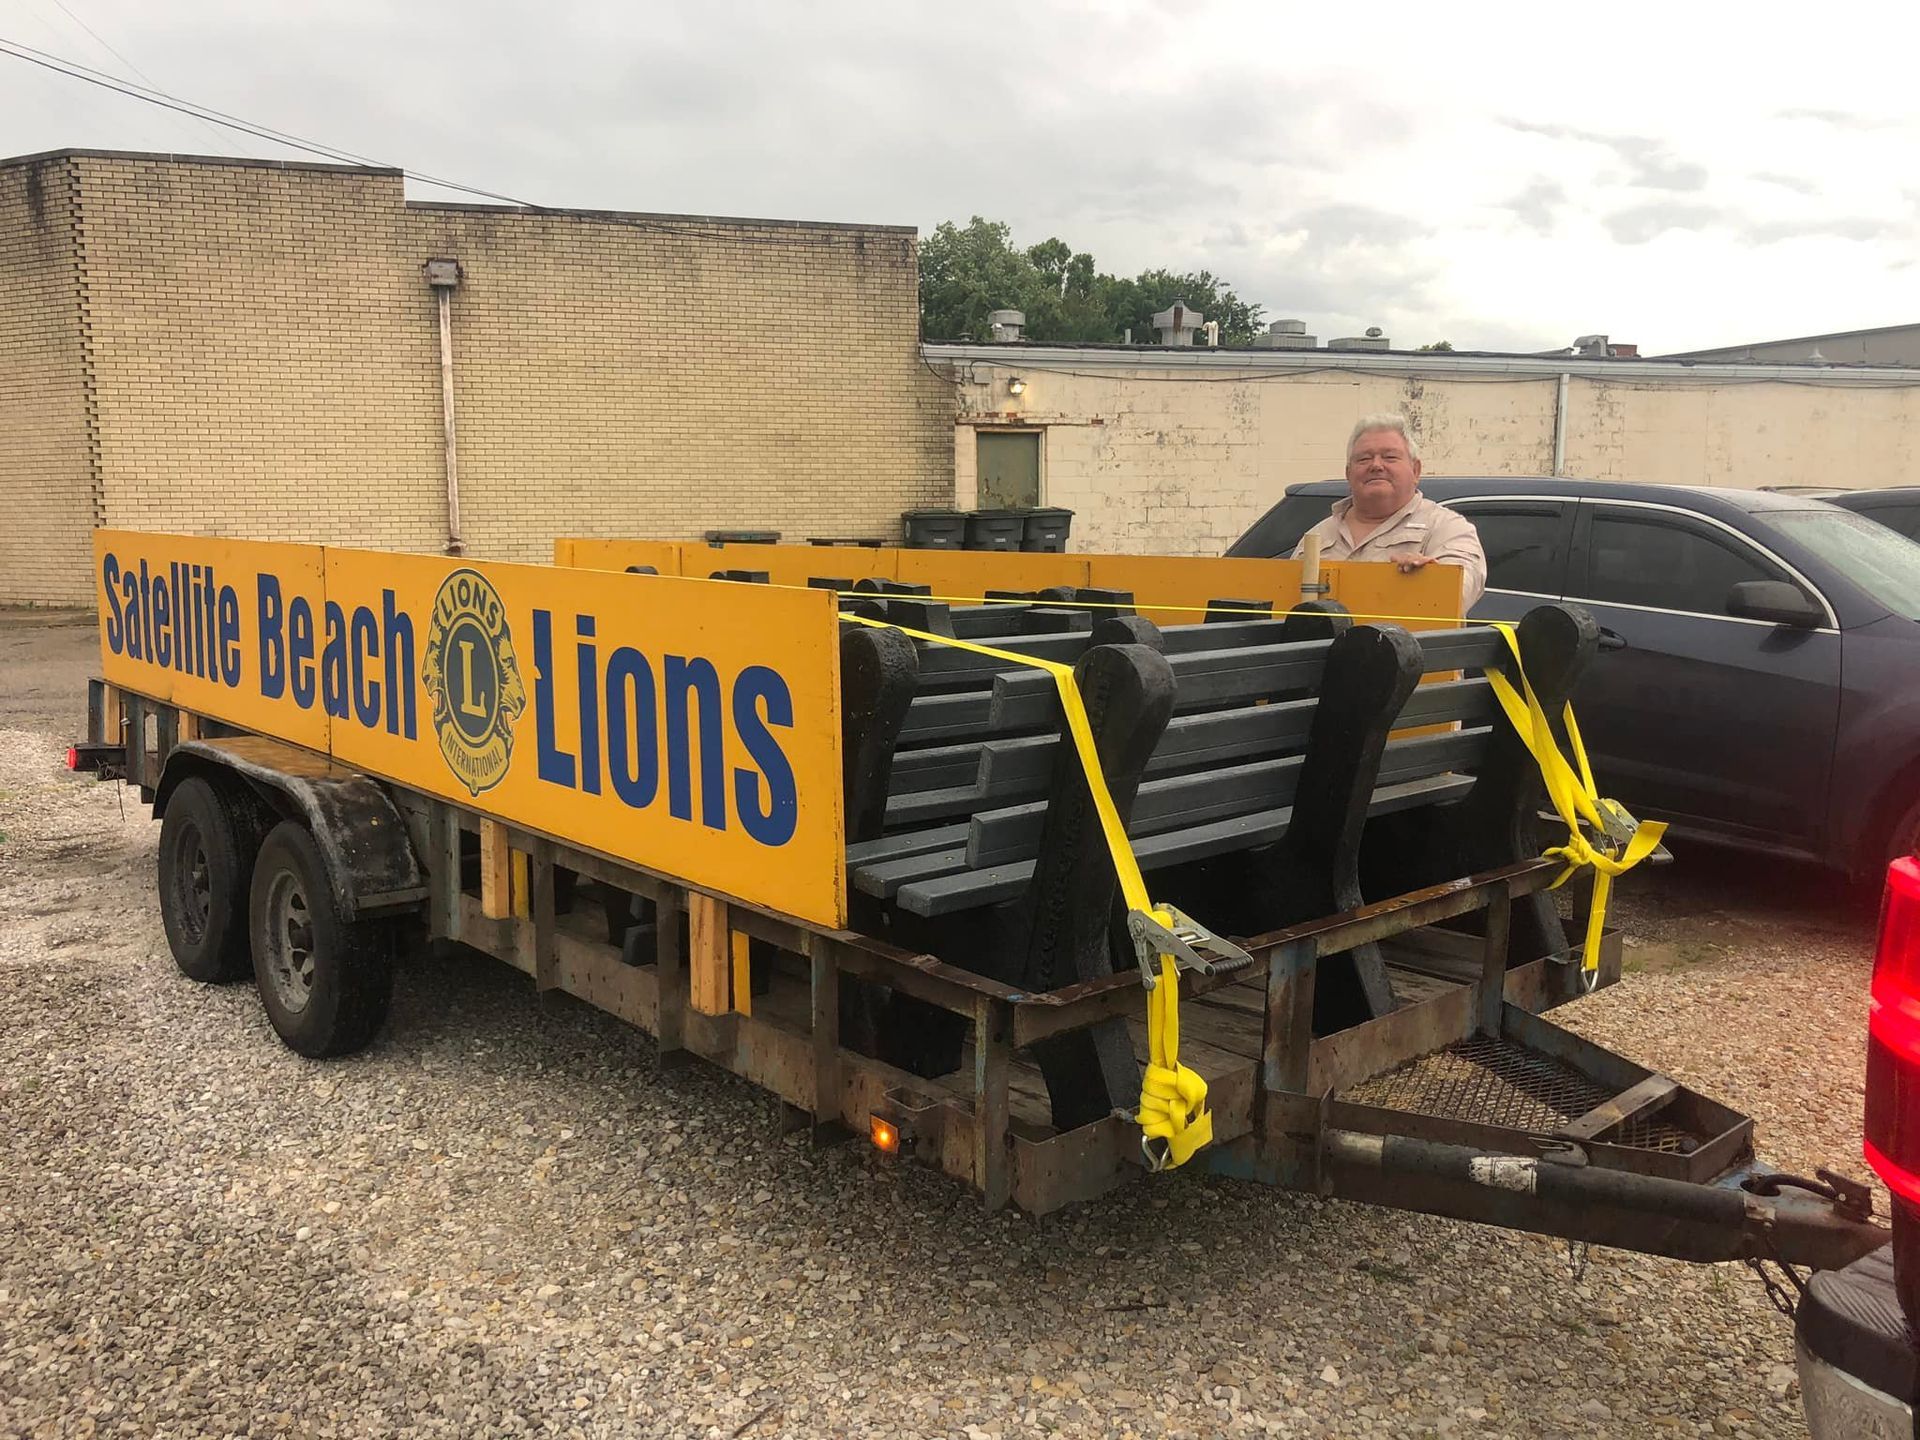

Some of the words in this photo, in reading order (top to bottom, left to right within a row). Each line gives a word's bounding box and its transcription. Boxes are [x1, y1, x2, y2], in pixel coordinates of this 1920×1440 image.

[440, 578, 499, 631] LIONS
[103, 553, 241, 688] Satellite
[257, 573, 417, 741] Beach
[533, 609, 798, 847] Lions
[458, 639, 487, 718] L
[445, 732, 503, 778] INTERNATIONAL
